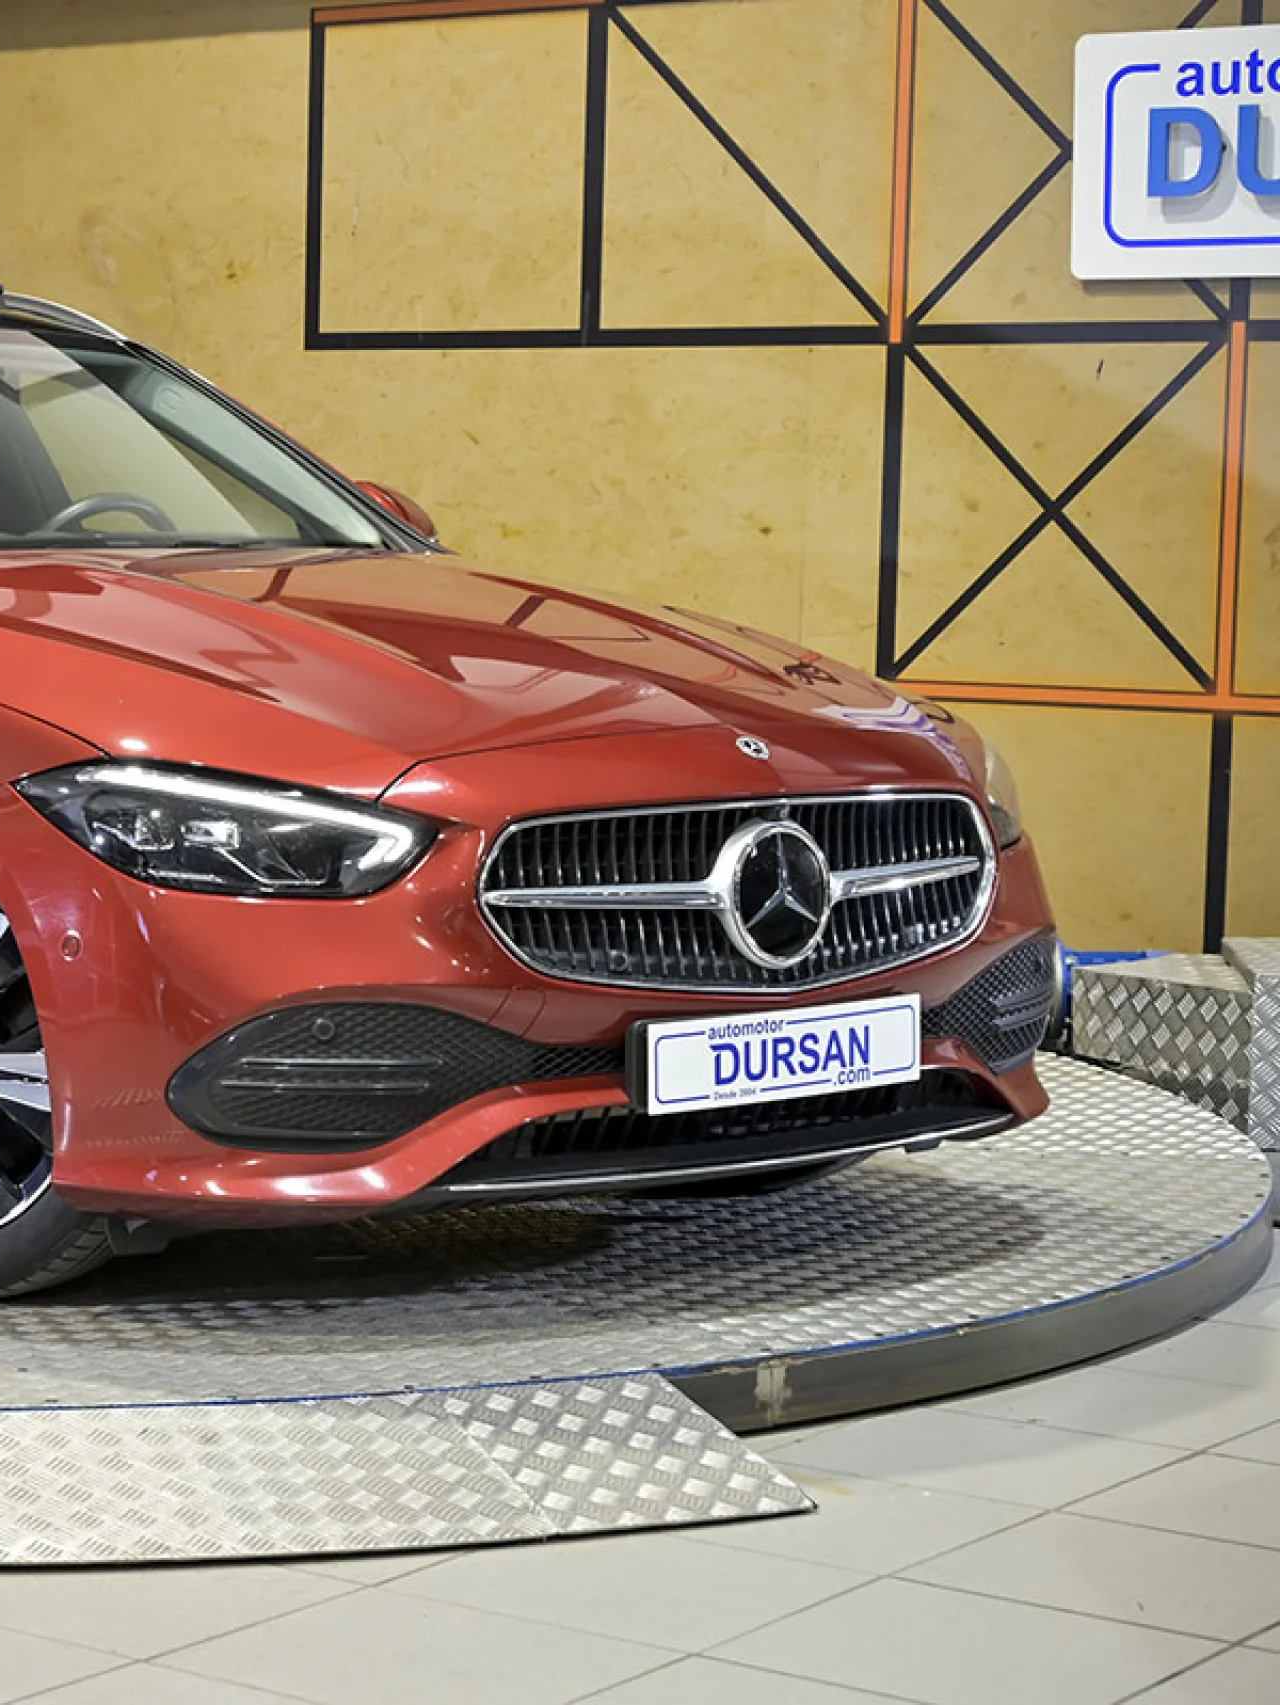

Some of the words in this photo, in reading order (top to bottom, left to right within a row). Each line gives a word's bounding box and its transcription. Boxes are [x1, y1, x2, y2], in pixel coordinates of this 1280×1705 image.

[707, 1018, 785, 1040] automotor
[710, 1024, 870, 1086] DURSAN
[833, 1066, 871, 1086] .com
